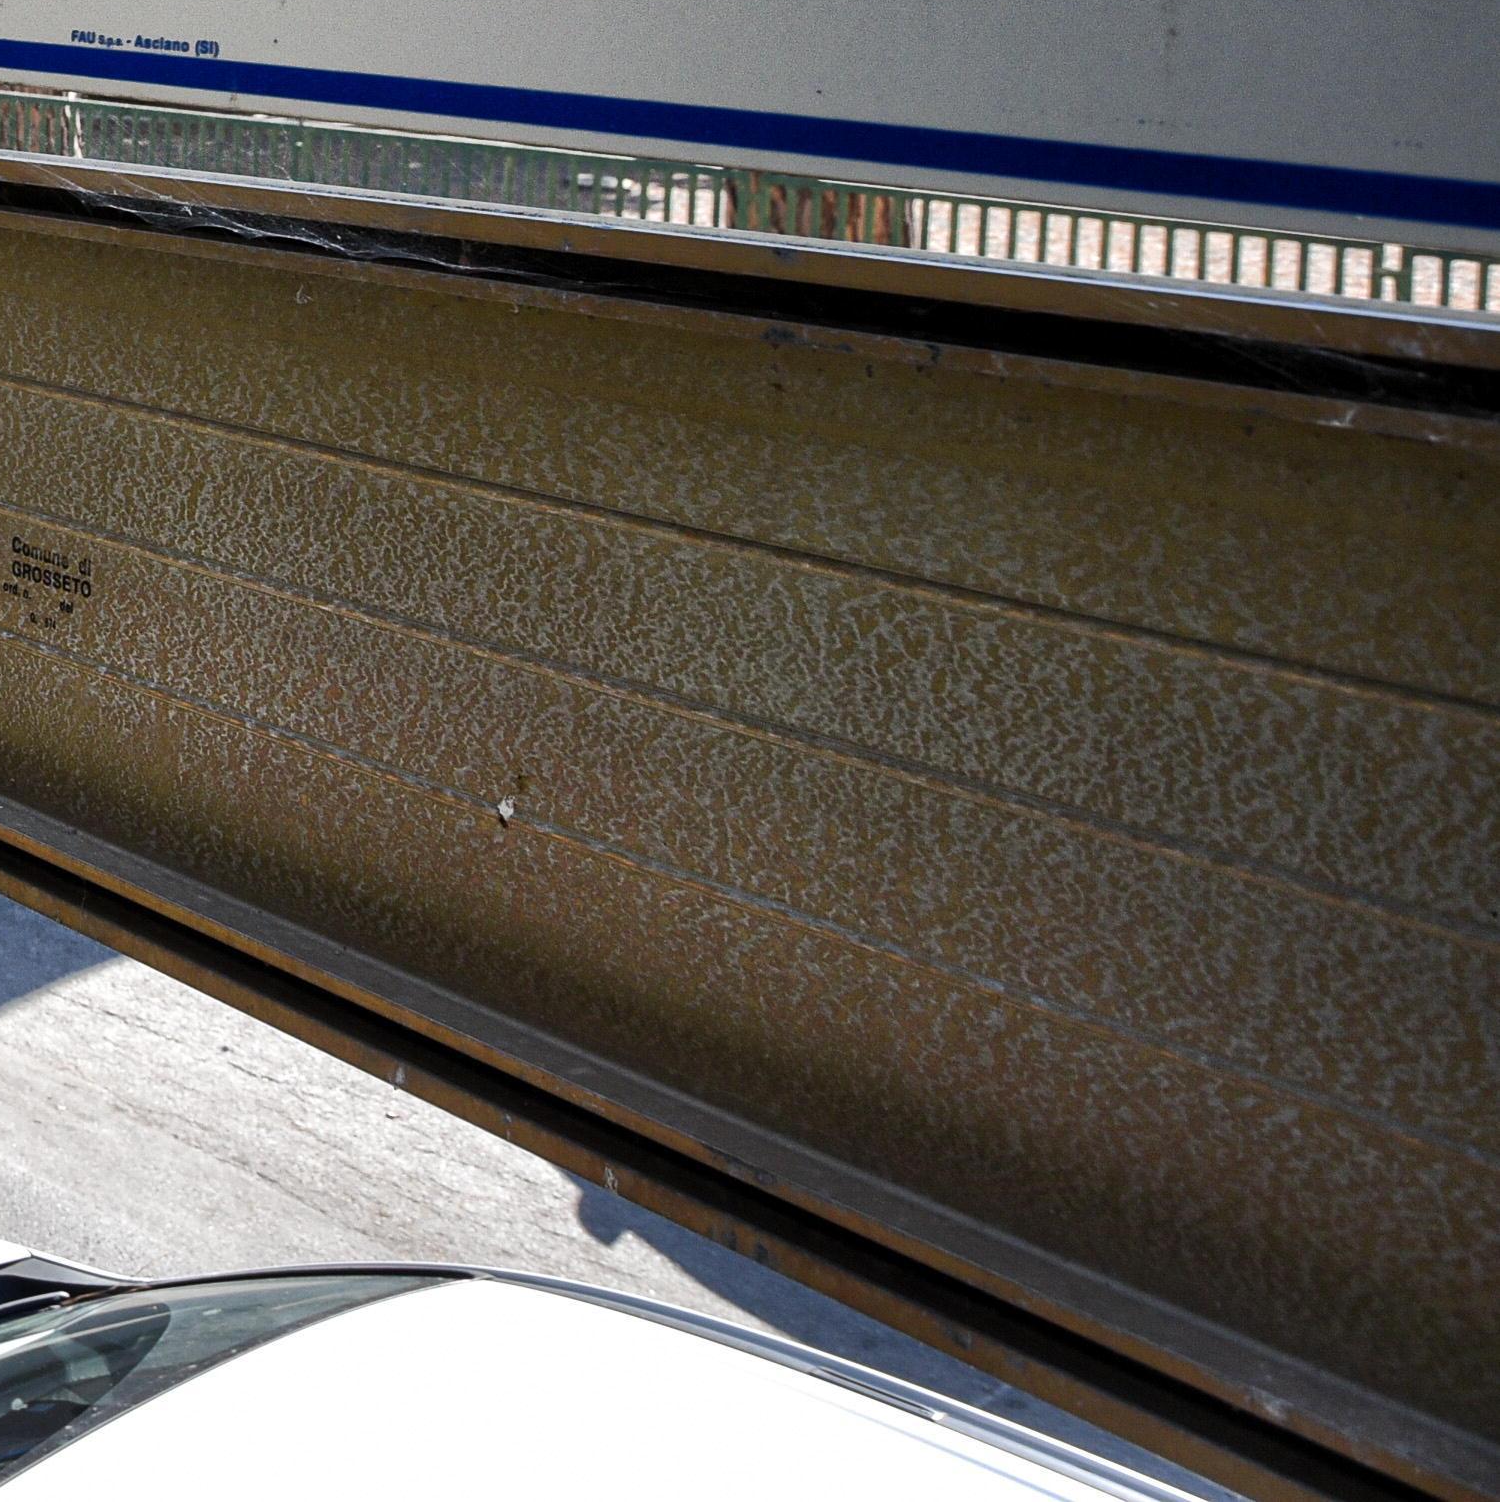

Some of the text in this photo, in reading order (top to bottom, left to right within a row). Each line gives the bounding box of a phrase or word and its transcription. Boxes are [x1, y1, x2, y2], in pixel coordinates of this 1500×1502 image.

[71, 30, 96, 44] FAU
[134, 35, 190, 53] Asciano
[195, 40, 220, 58] (SI)
[12, 537, 91, 576] Comune di
[12, 560, 91, 598] GROSSETO
